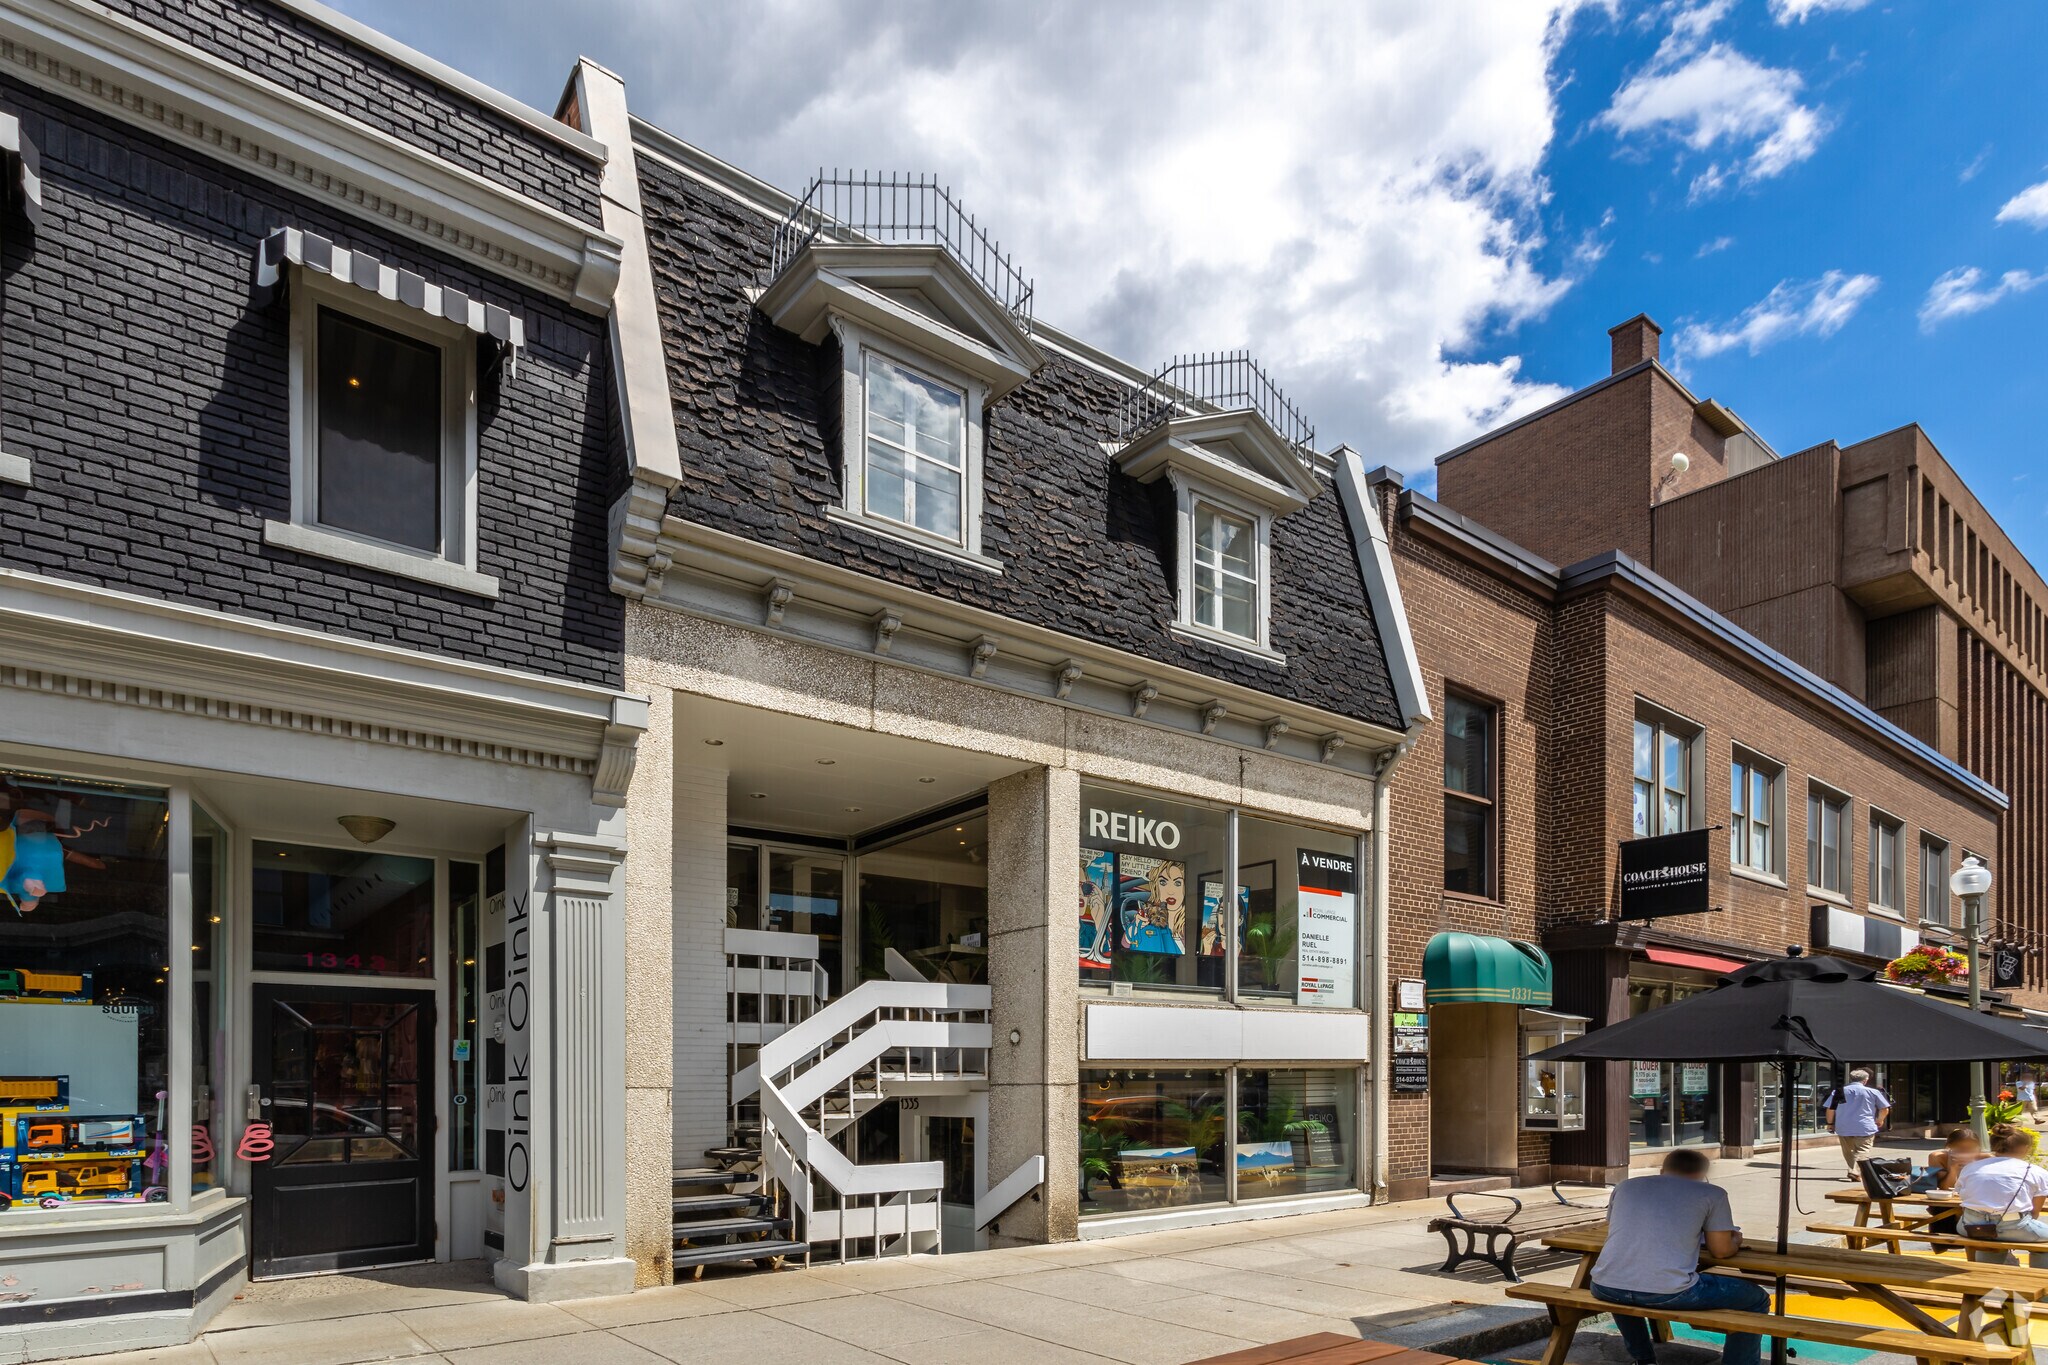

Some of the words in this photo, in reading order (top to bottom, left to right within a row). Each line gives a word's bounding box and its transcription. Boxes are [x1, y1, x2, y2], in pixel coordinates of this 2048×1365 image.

[1089, 807, 1180, 850] REIKO
[1133, 856, 1151, 864] HELLO
[1301, 852, 1310, 866] À
[1311, 856, 1353, 873] VENDRE
[1131, 862, 1150, 870] LITTLE
[1623, 869, 1660, 883] COACH
[1669, 862, 1707, 876] HOUSE
[1671, 878, 1703, 887] BIJOUTERIE
[1312, 912, 1348, 923] COMMERCIAL
[1301, 932, 1330, 942] DANIELLE
[1301, 941, 1318, 949] RUEL
[303, 952, 386, 970] 1343
[508, 888, 529, 1032] Oink
[1301, 954, 1347, 965] 514-898-8891
[1511, 987, 1532, 1001] 1331
[1640, 1061, 1659, 1071] LOUER
[900, 1097, 920, 1110] 1335
[508, 1052, 529, 1193] Oink
[1309, 1113, 1334, 1123] REIKO
[106, 1192, 135, 1200] bruder
